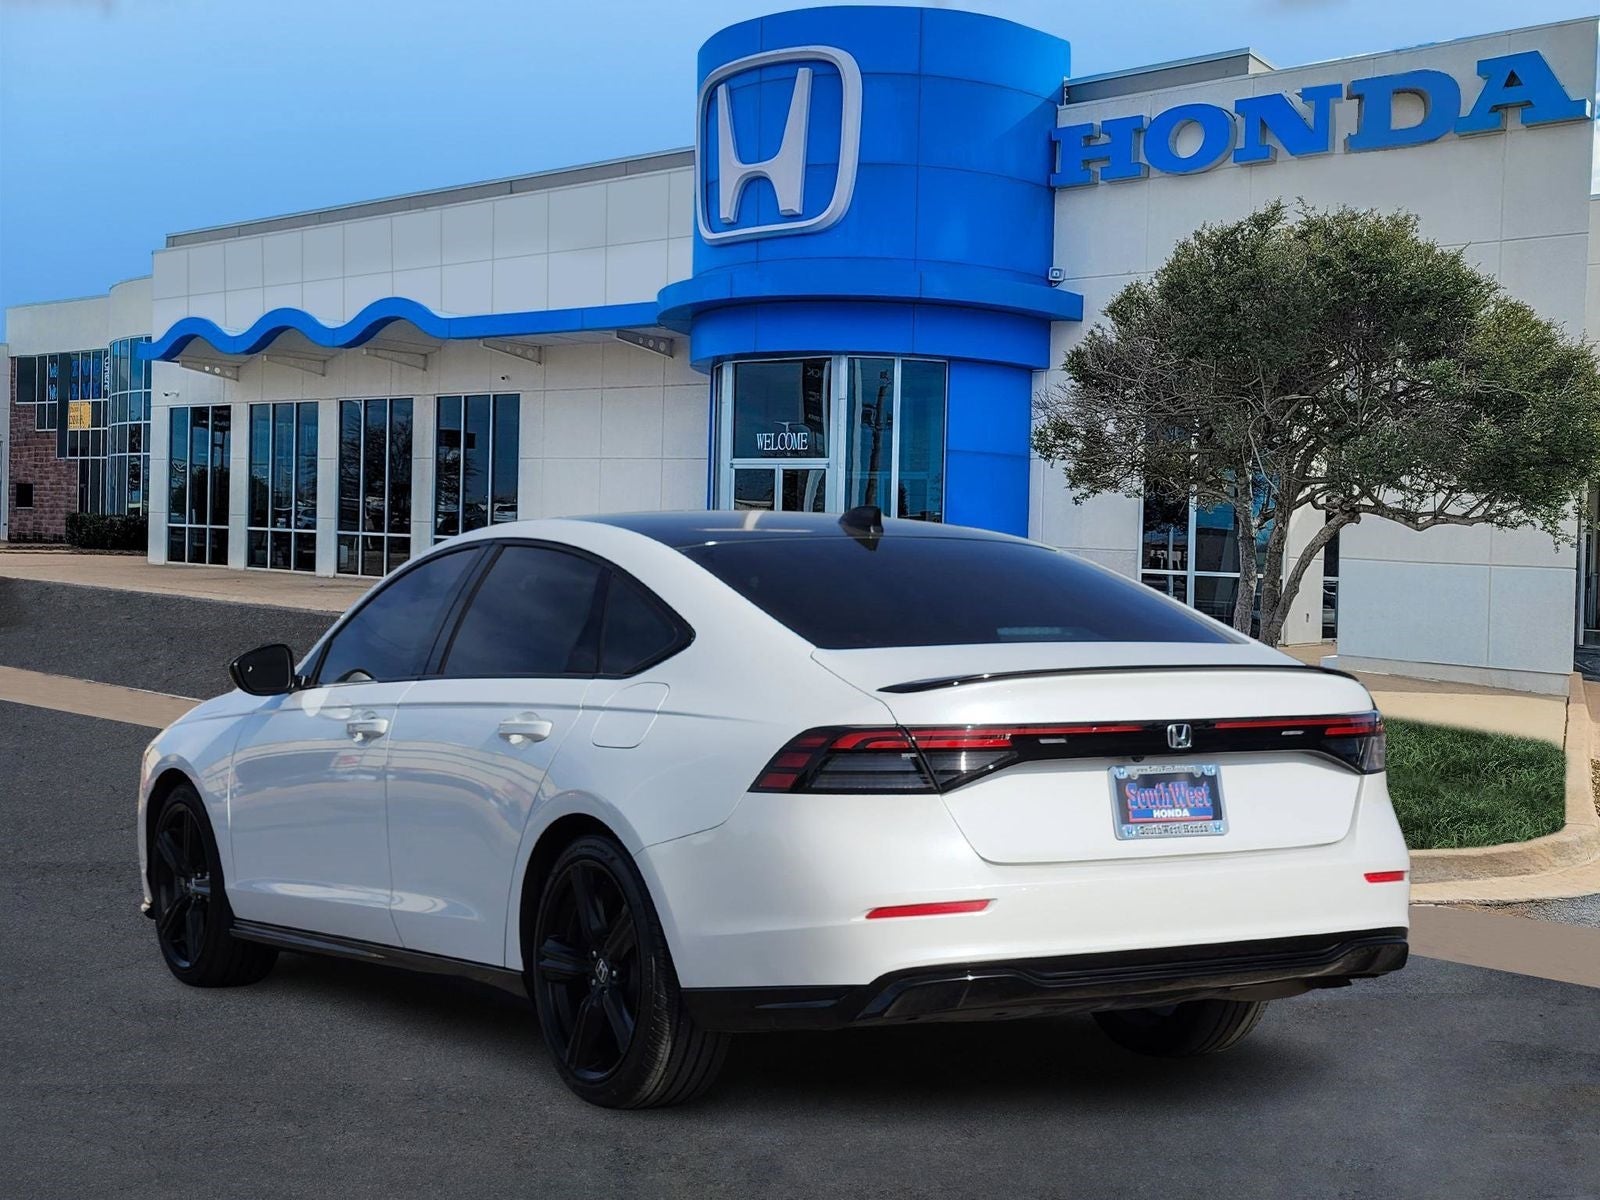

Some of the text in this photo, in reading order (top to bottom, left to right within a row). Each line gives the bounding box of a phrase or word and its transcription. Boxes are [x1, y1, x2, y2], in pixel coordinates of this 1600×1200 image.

[1050, 50, 1592, 189] HONDA
[756, 432, 808, 451] WELCOME
[1153, 808, 1190, 818] HONDA
